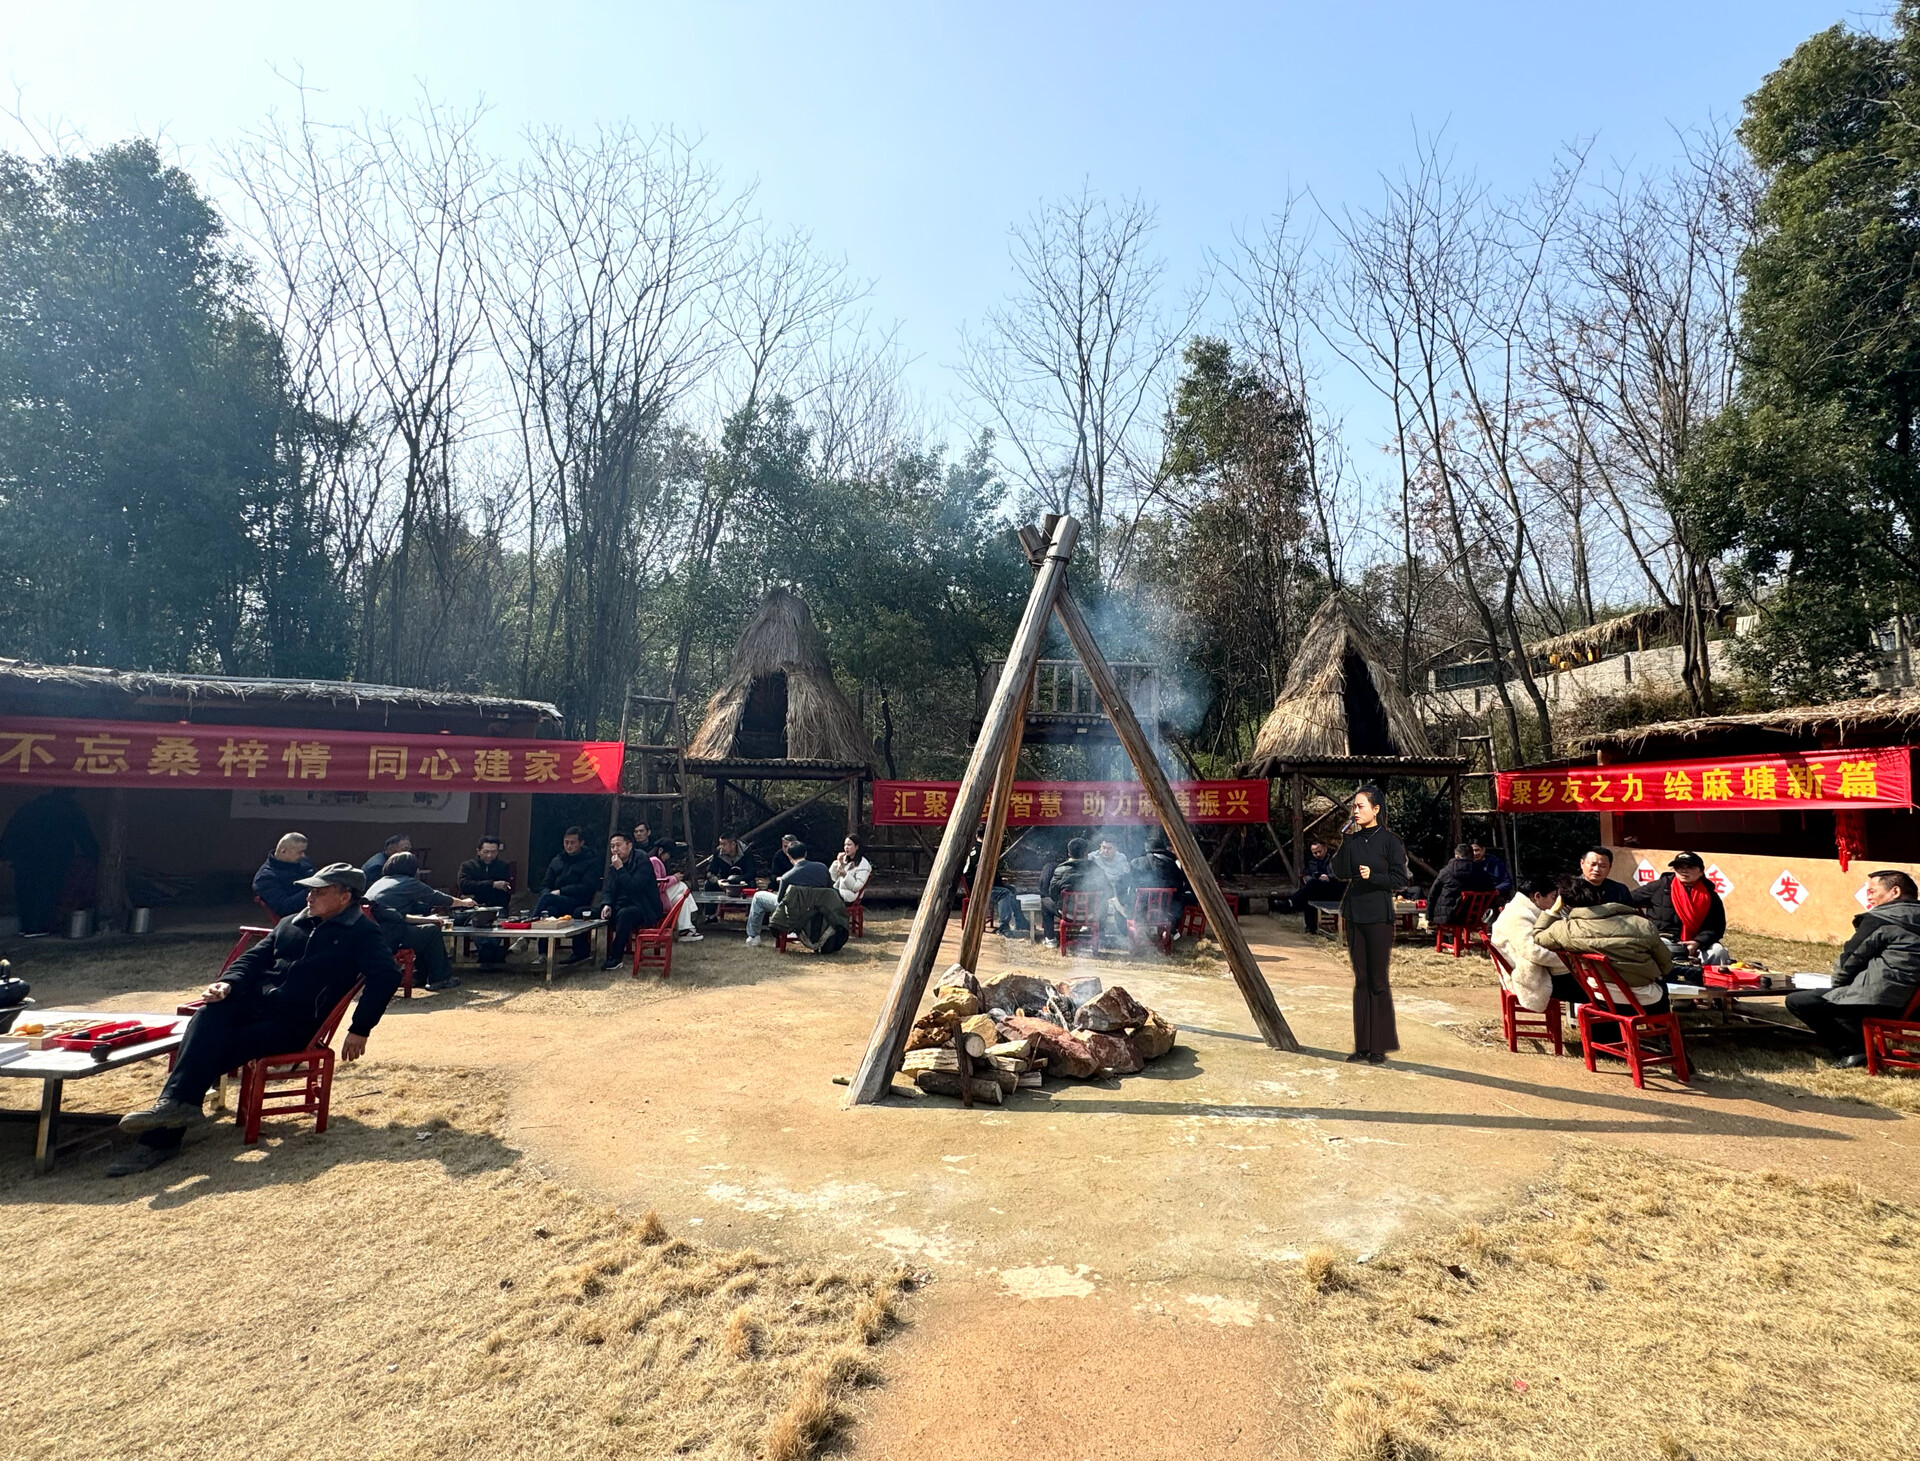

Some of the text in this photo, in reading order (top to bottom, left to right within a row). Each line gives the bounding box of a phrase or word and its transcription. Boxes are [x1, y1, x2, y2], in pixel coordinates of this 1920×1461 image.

[0, 732, 601, 784] 不忘桑梓情 同心建家乡
[1512, 760, 1878, 805] 聚乡友之力 绘麻塘新篇
[893, 790, 1063, 818] 汇聚智慧
[1776, 876, 1800, 905] 发
